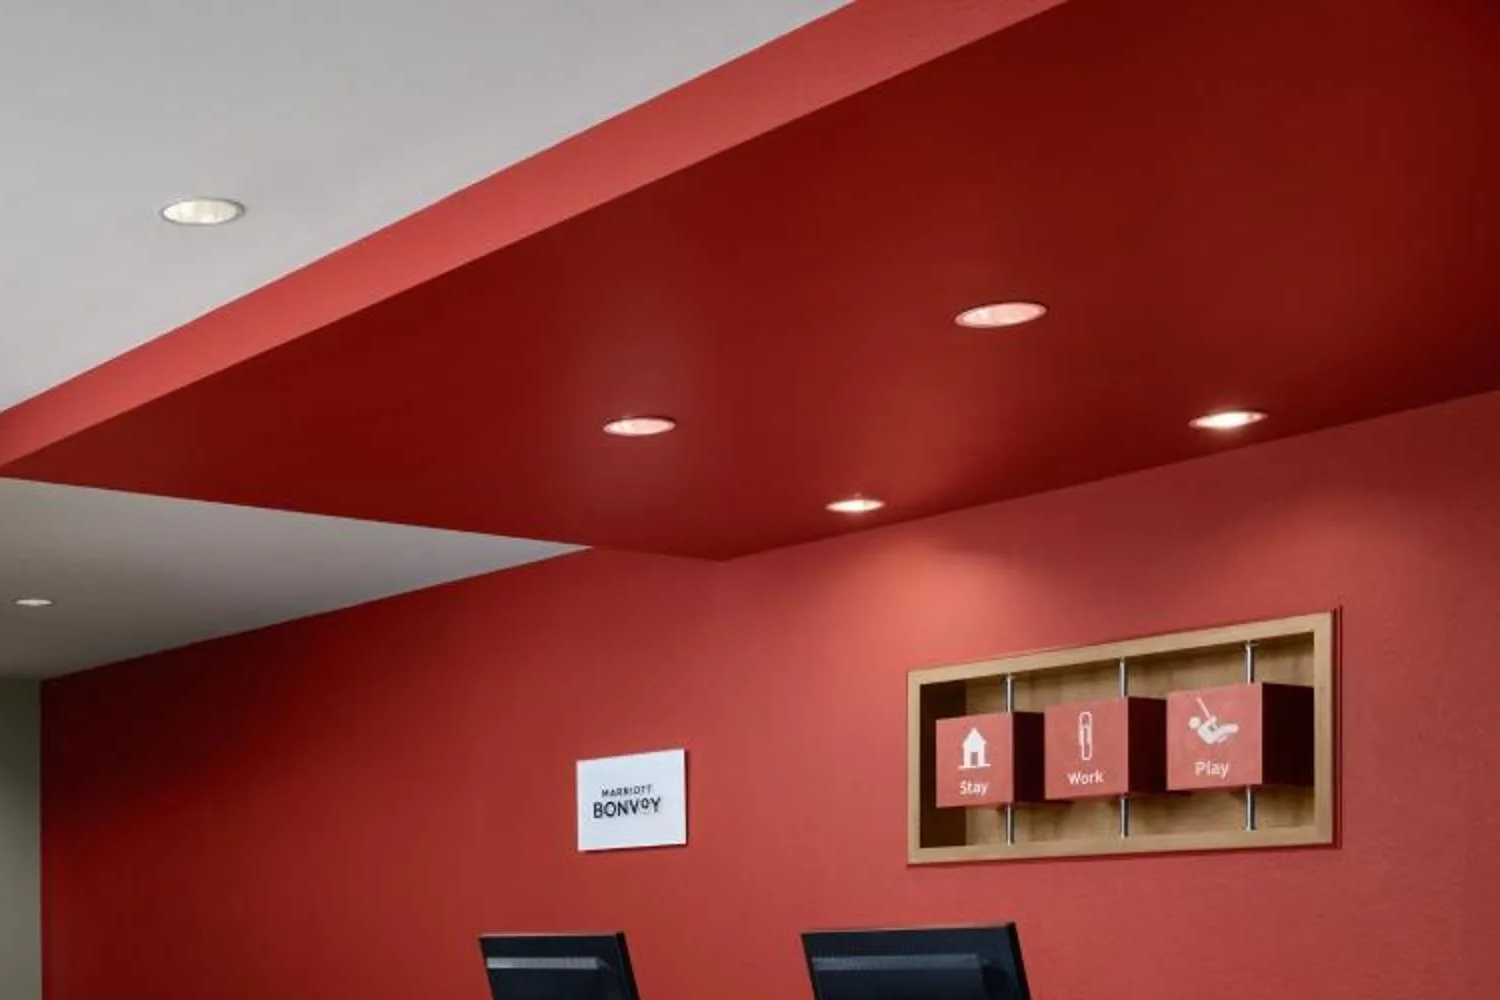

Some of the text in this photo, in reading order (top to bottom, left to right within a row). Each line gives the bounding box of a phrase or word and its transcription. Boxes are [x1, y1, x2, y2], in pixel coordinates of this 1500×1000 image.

[1068, 769, 1104, 786] Work
[1194, 760, 1230, 779] Play
[601, 784, 652, 798] MARRIOTT
[959, 780, 989, 797] Stay
[593, 797, 661, 819] BONVOY
